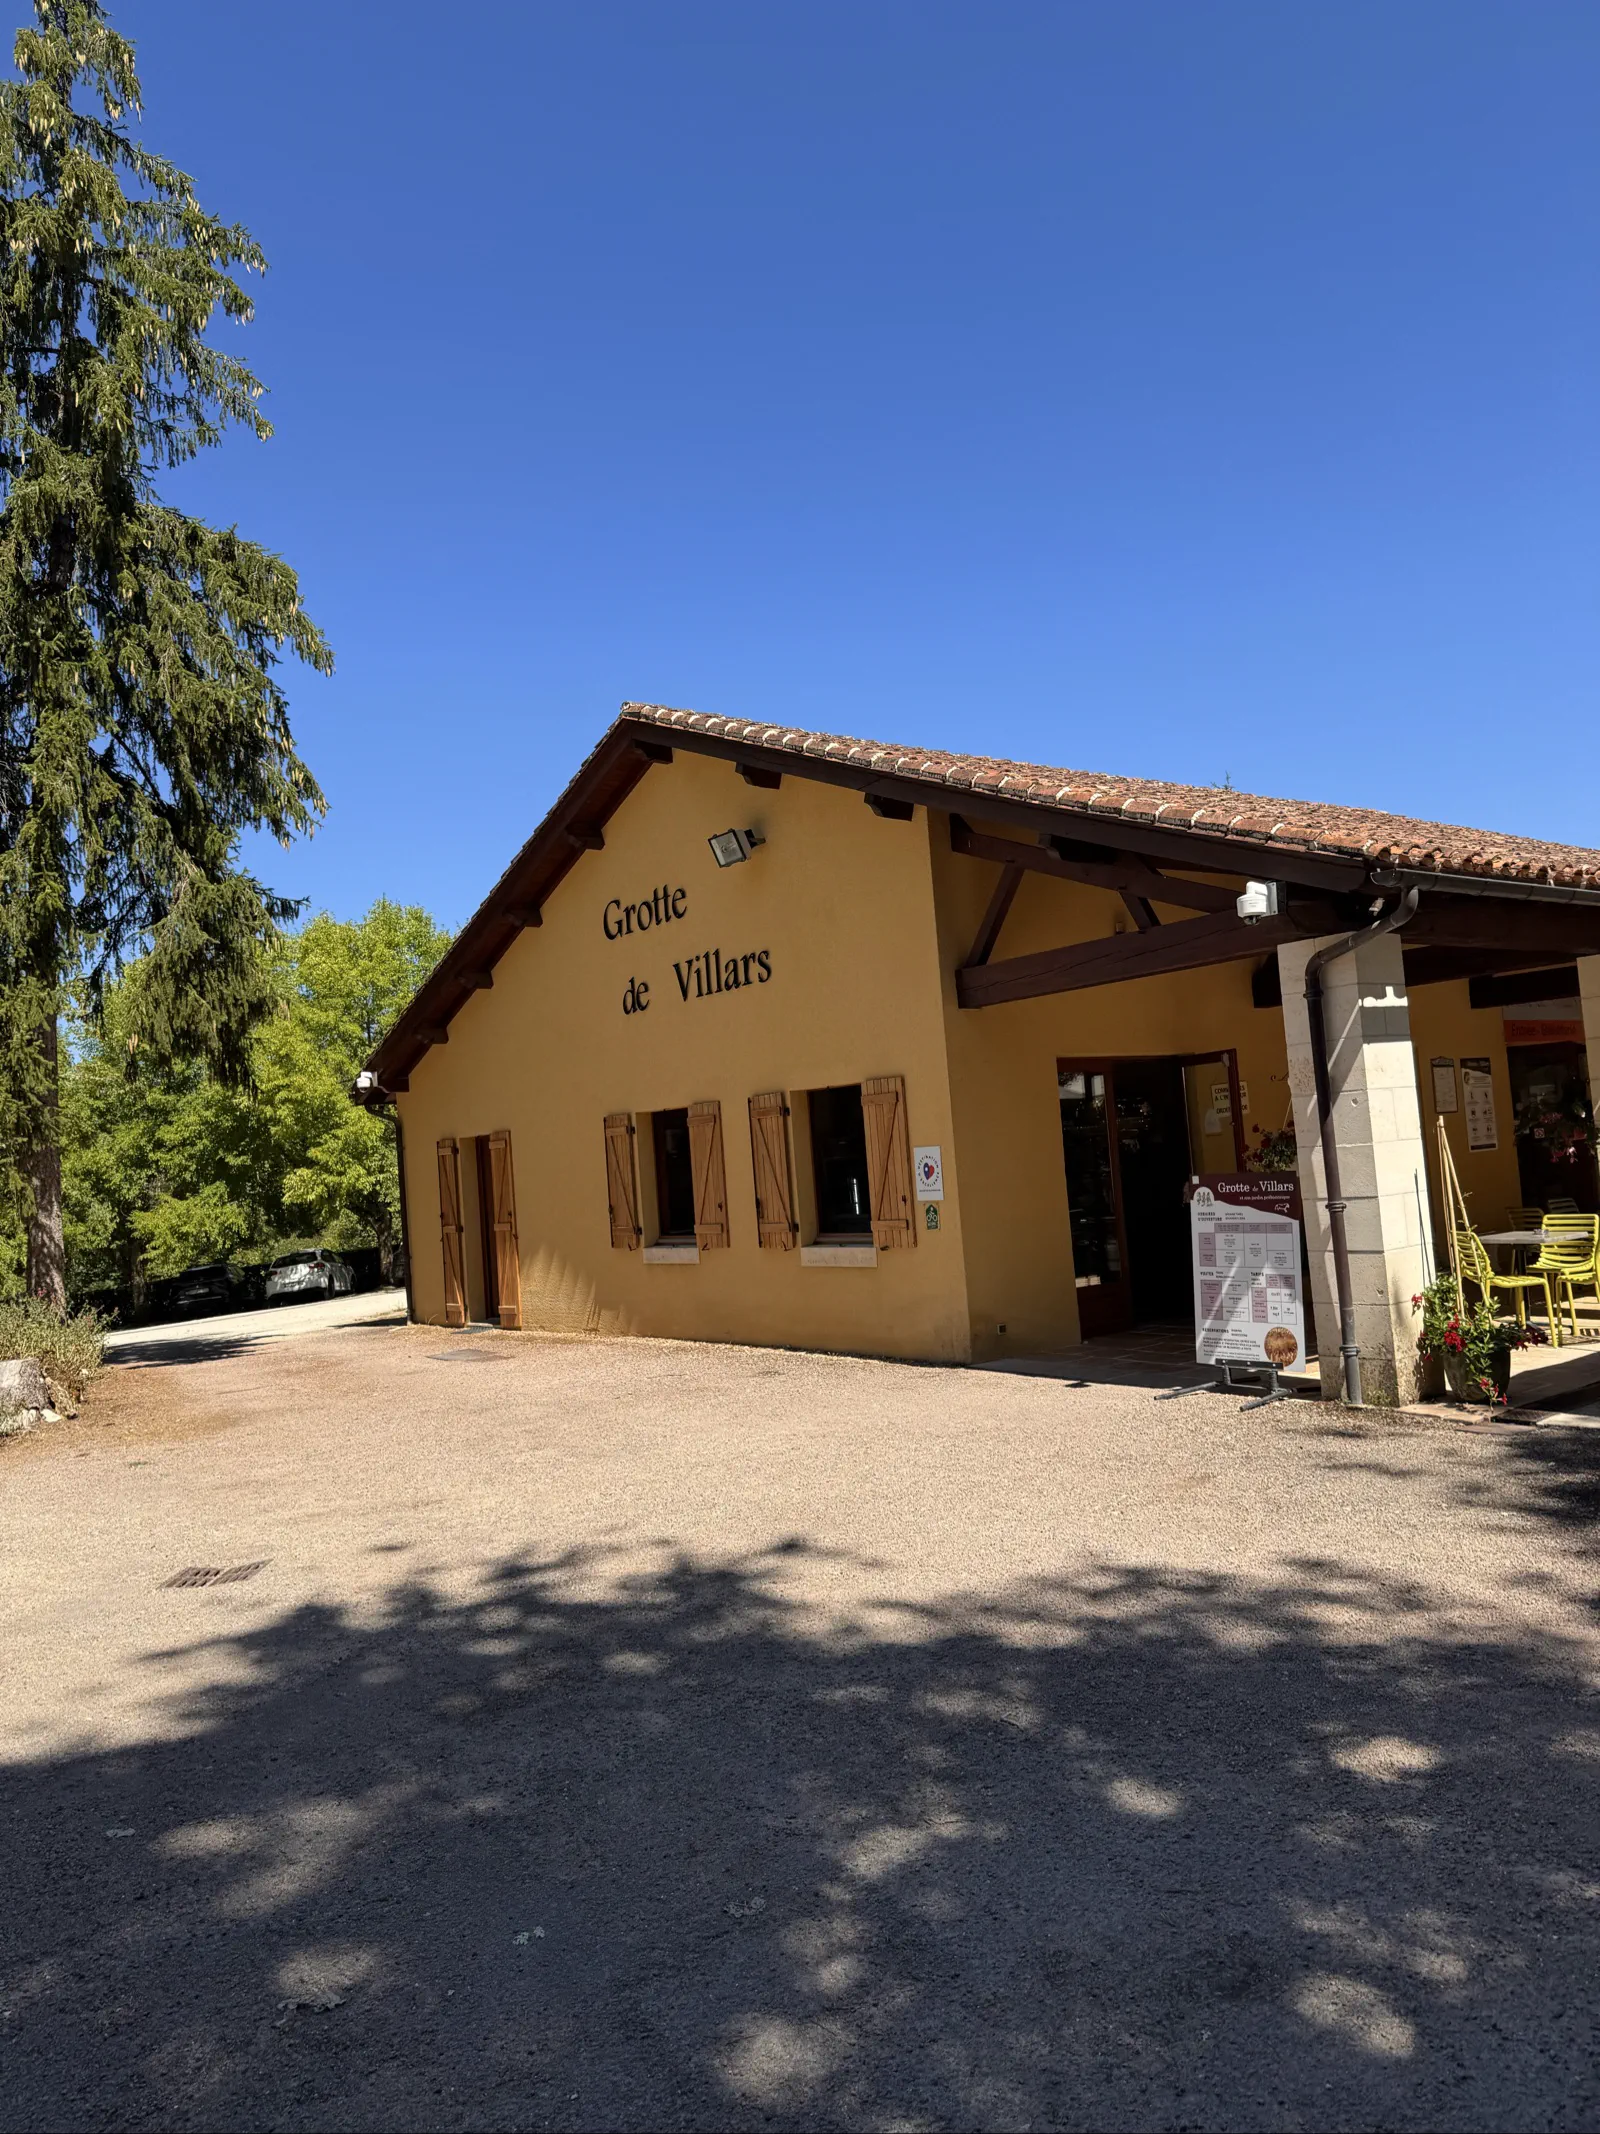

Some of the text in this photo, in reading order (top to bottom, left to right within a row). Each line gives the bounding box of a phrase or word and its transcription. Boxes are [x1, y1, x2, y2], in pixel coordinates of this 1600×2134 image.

[602, 884, 688, 941] Grotte
[622, 948, 773, 1016] de Villars
[1217, 1182, 1250, 1193] Grotte
[1259, 1180, 1295, 1192] Villars
